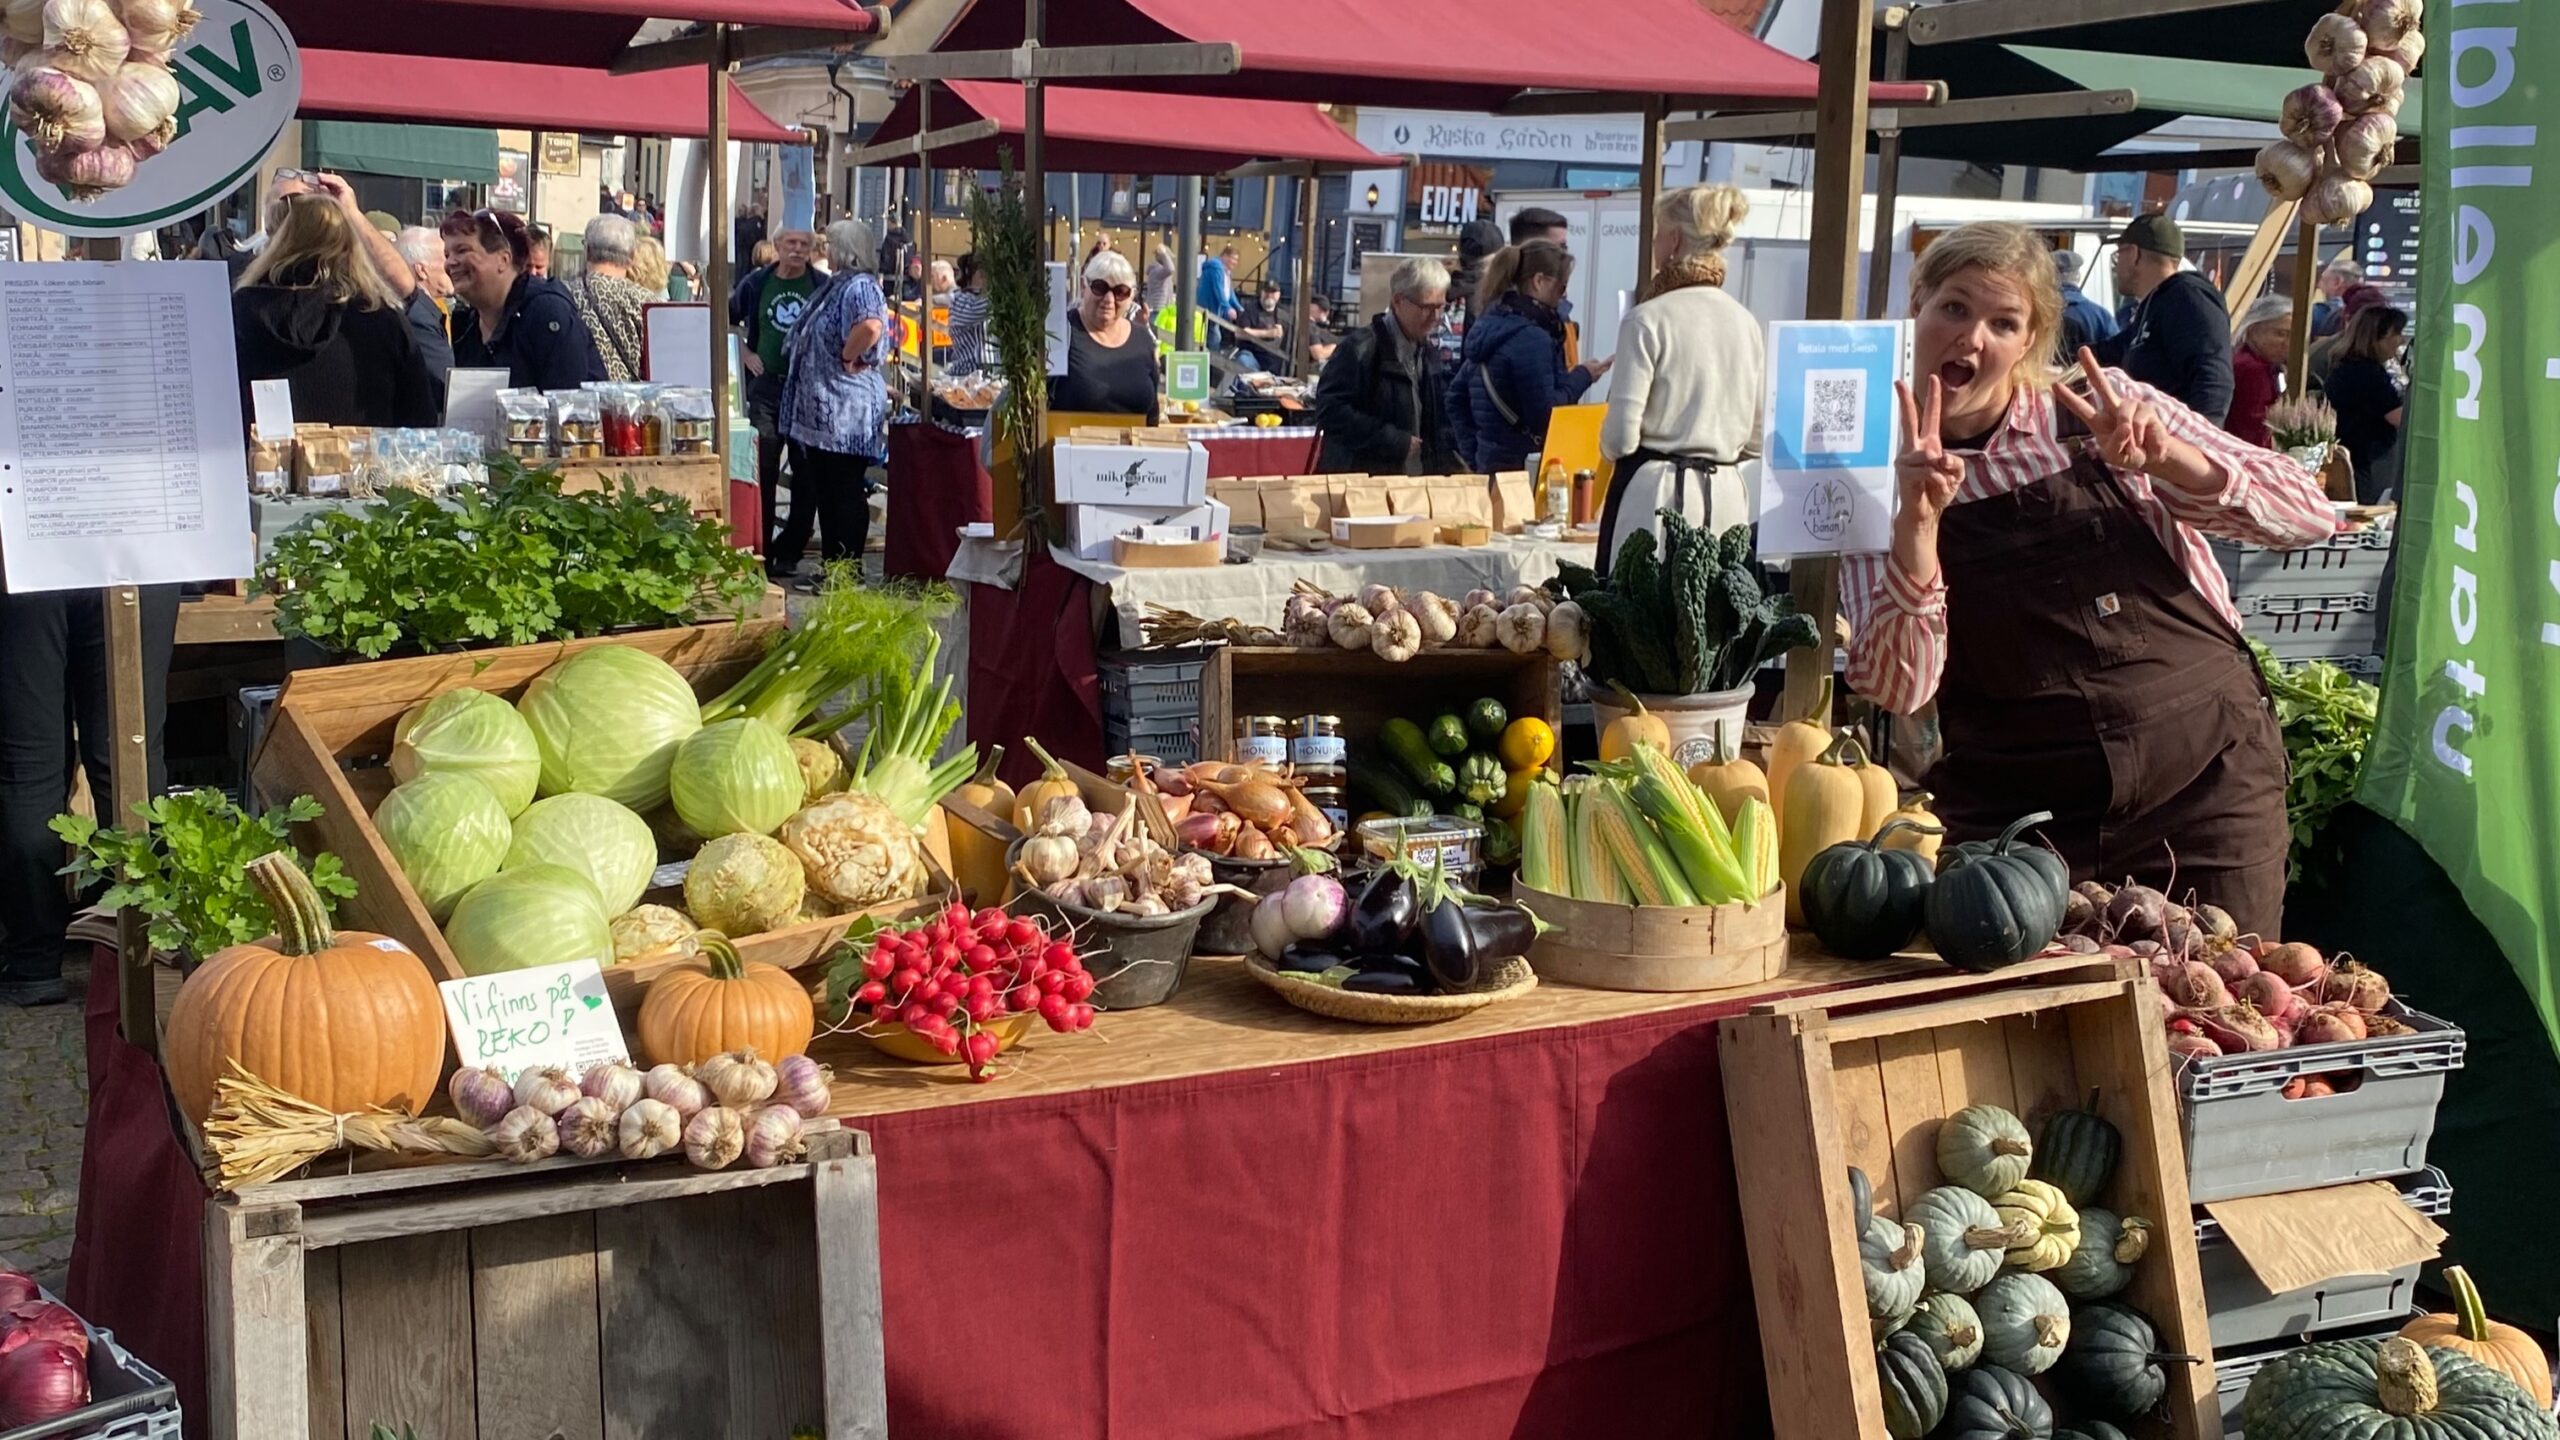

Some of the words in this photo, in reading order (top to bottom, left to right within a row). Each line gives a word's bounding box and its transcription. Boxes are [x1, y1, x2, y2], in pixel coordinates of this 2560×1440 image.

[1420, 185, 1479, 223] EDEN
[1241, 745, 1285, 757] HONUNG
[1298, 745, 1342, 757] HONUNG
[486, 981, 538, 1027] finns
[546, 972, 572, 1019] på
